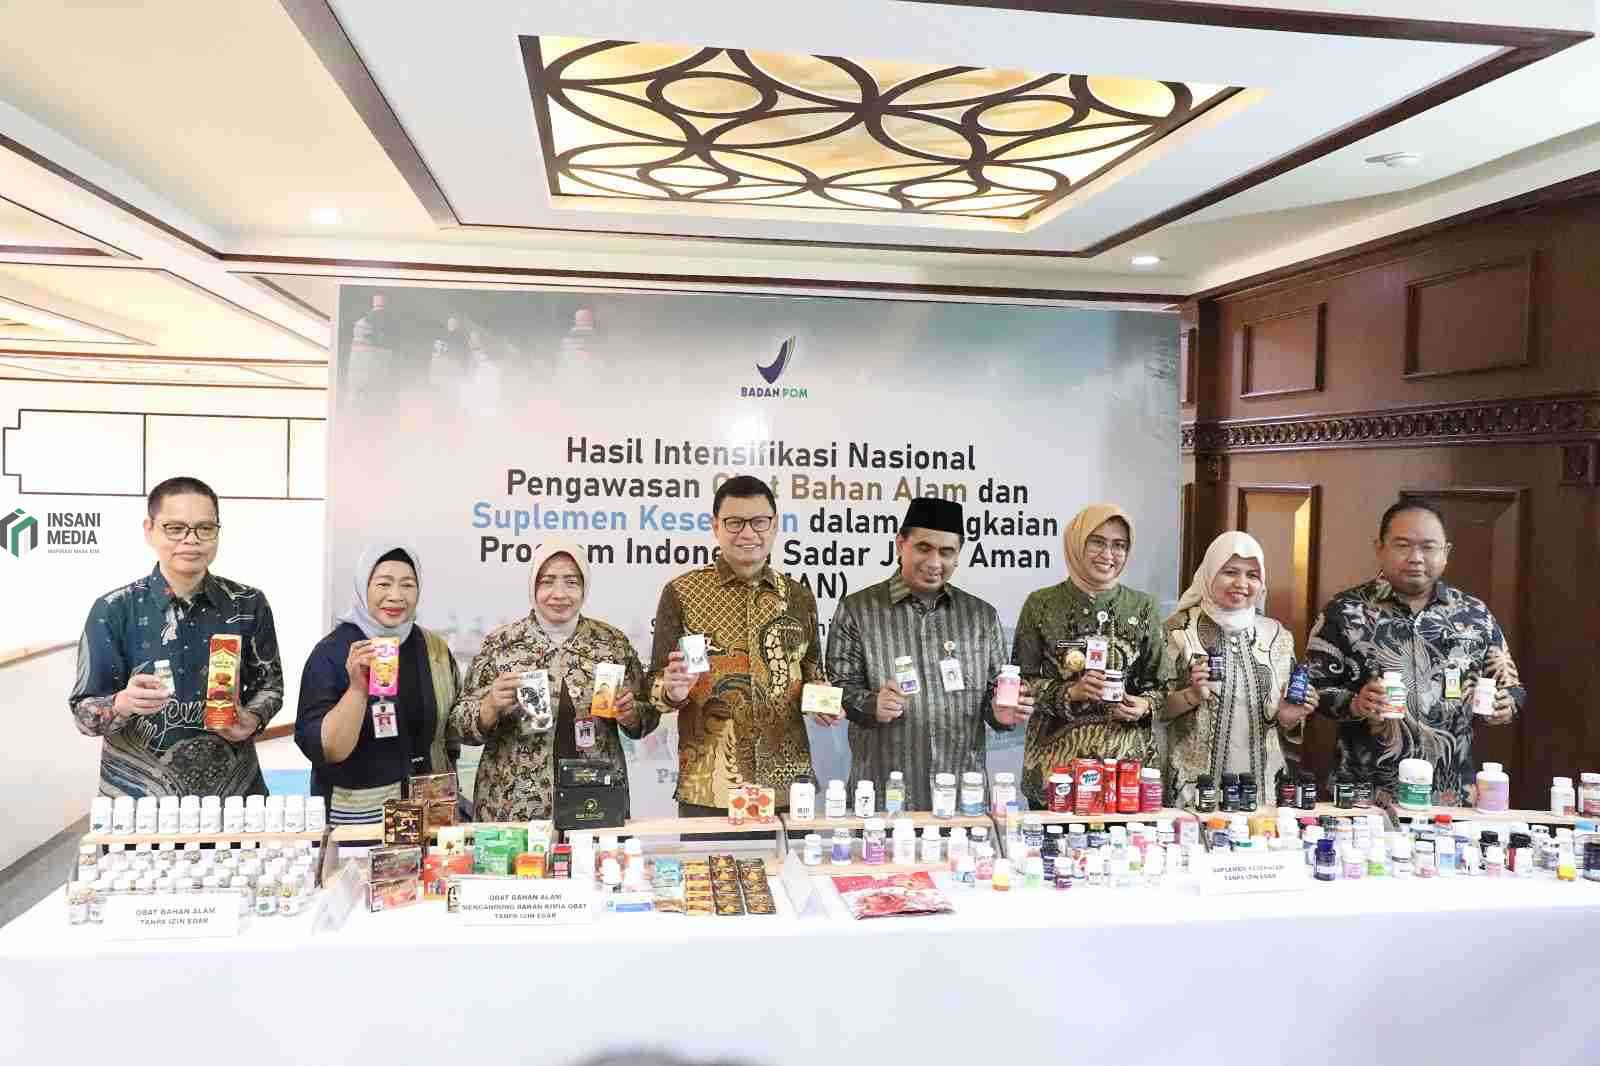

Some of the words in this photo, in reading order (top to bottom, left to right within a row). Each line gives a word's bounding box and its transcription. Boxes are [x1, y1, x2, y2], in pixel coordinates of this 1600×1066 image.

[741, 386, 780, 398] BADAN
[783, 388, 808, 398] POM
[567, 437, 643, 464] Hasil
[654, 438, 837, 467] Intensifikasi
[849, 442, 976, 470] Nasional
[507, 469, 700, 503] Pengawasan
[791, 474, 882, 500] Bahan
[893, 476, 967, 502] Alam
[978, 478, 1028, 503] dan
[472, 502, 627, 536] Suplemen
[809, 508, 899, 534] dalam
[480, 535, 615, 564] Prom
[783, 540, 871, 566] Sadar
[968, 542, 1051, 569] Aman
